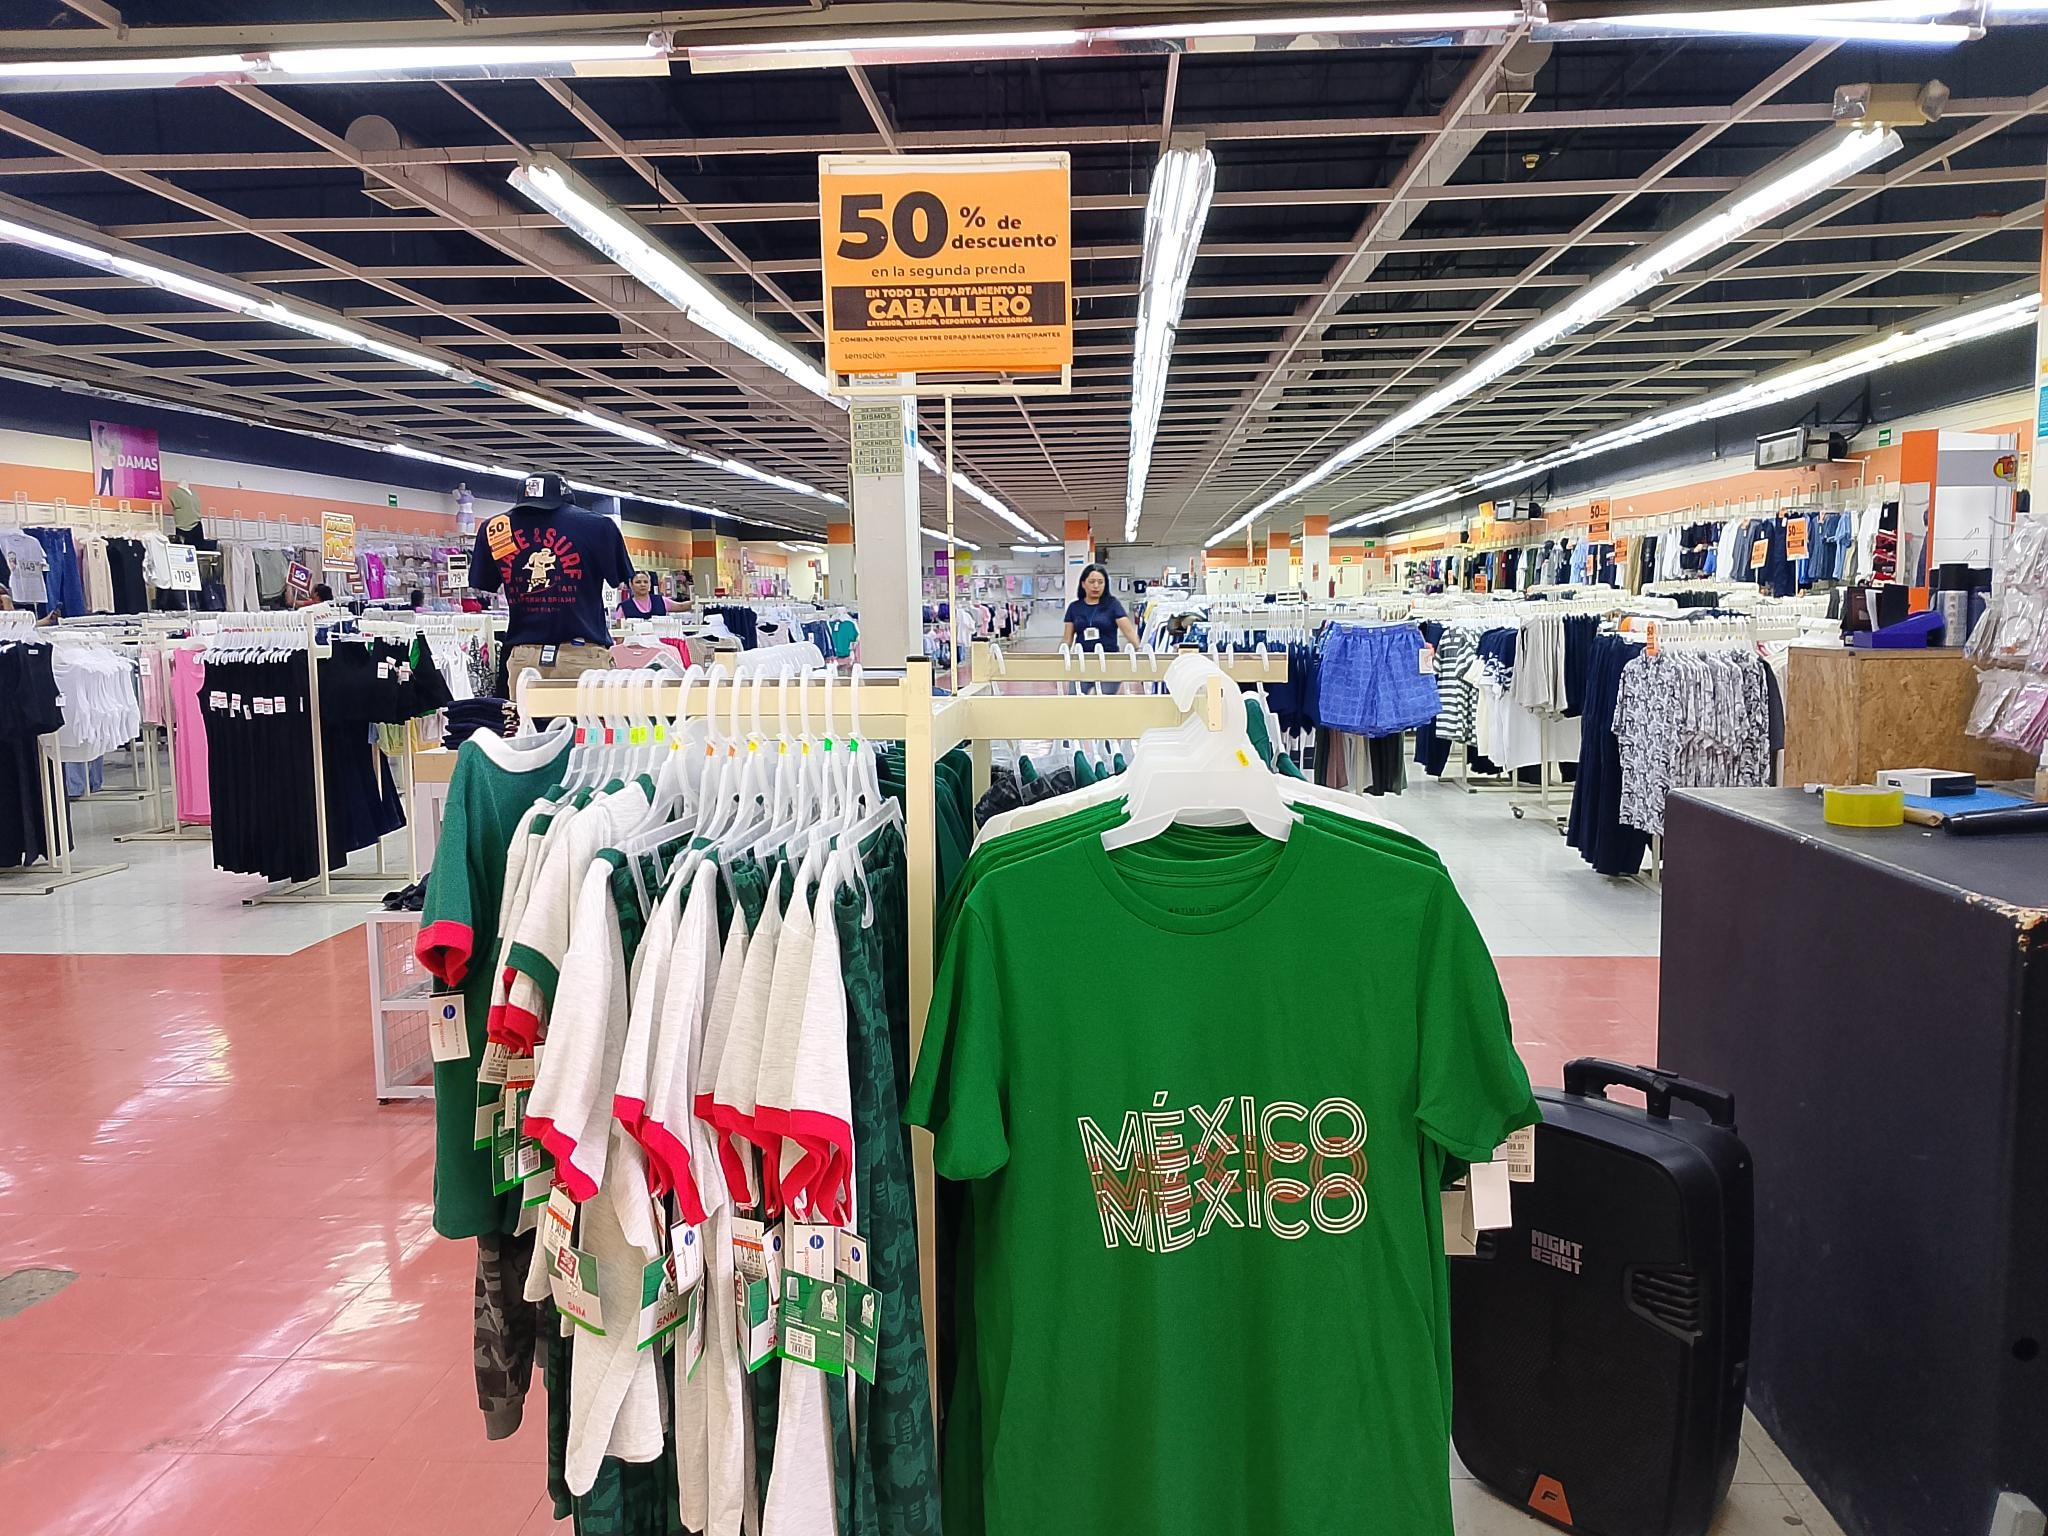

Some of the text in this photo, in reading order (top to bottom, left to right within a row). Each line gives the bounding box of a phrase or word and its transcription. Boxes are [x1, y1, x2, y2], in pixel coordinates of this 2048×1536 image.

[837, 190, 1022, 260] 50 % de
[951, 234, 1057, 249] descuento
[871, 264, 1026, 279] en la segunda prenda
[865, 285, 1032, 298] EN TODO EL DEPARTAMENTO DE
[868, 295, 1031, 319] CABALLERO
[940, 317, 981, 325] DEPORTIVO
[988, 316, 1033, 324] ACCESORIOS
[874, 335, 918, 343] PRODUCTOS
[943, 332, 1005, 340] DEPARTAMENTOS
[1006, 331, 1061, 340] PARTICIPANTES
[861, 412, 892, 421] SISMOS
[117, 454, 159, 471] DAMAS
[1590, 505, 1600, 519] 50
[488, 521, 505, 537] 50
[1788, 525, 1796, 537] 50
[533, 527, 542, 543] &
[543, 527, 583, 580] SURF
[294, 570, 306, 581] 50
[1261, 567, 1267, 575] 2
[1078, 1091, 1367, 1175] MÉXICO
[1097, 1170, 1368, 1253] MÉXICO
[1532, 1229, 1583, 1259] NIGHT
[1532, 1245, 1583, 1275] BEAST
[567, 1301, 586, 1318] SNM
[656, 1311, 678, 1329] SNM
